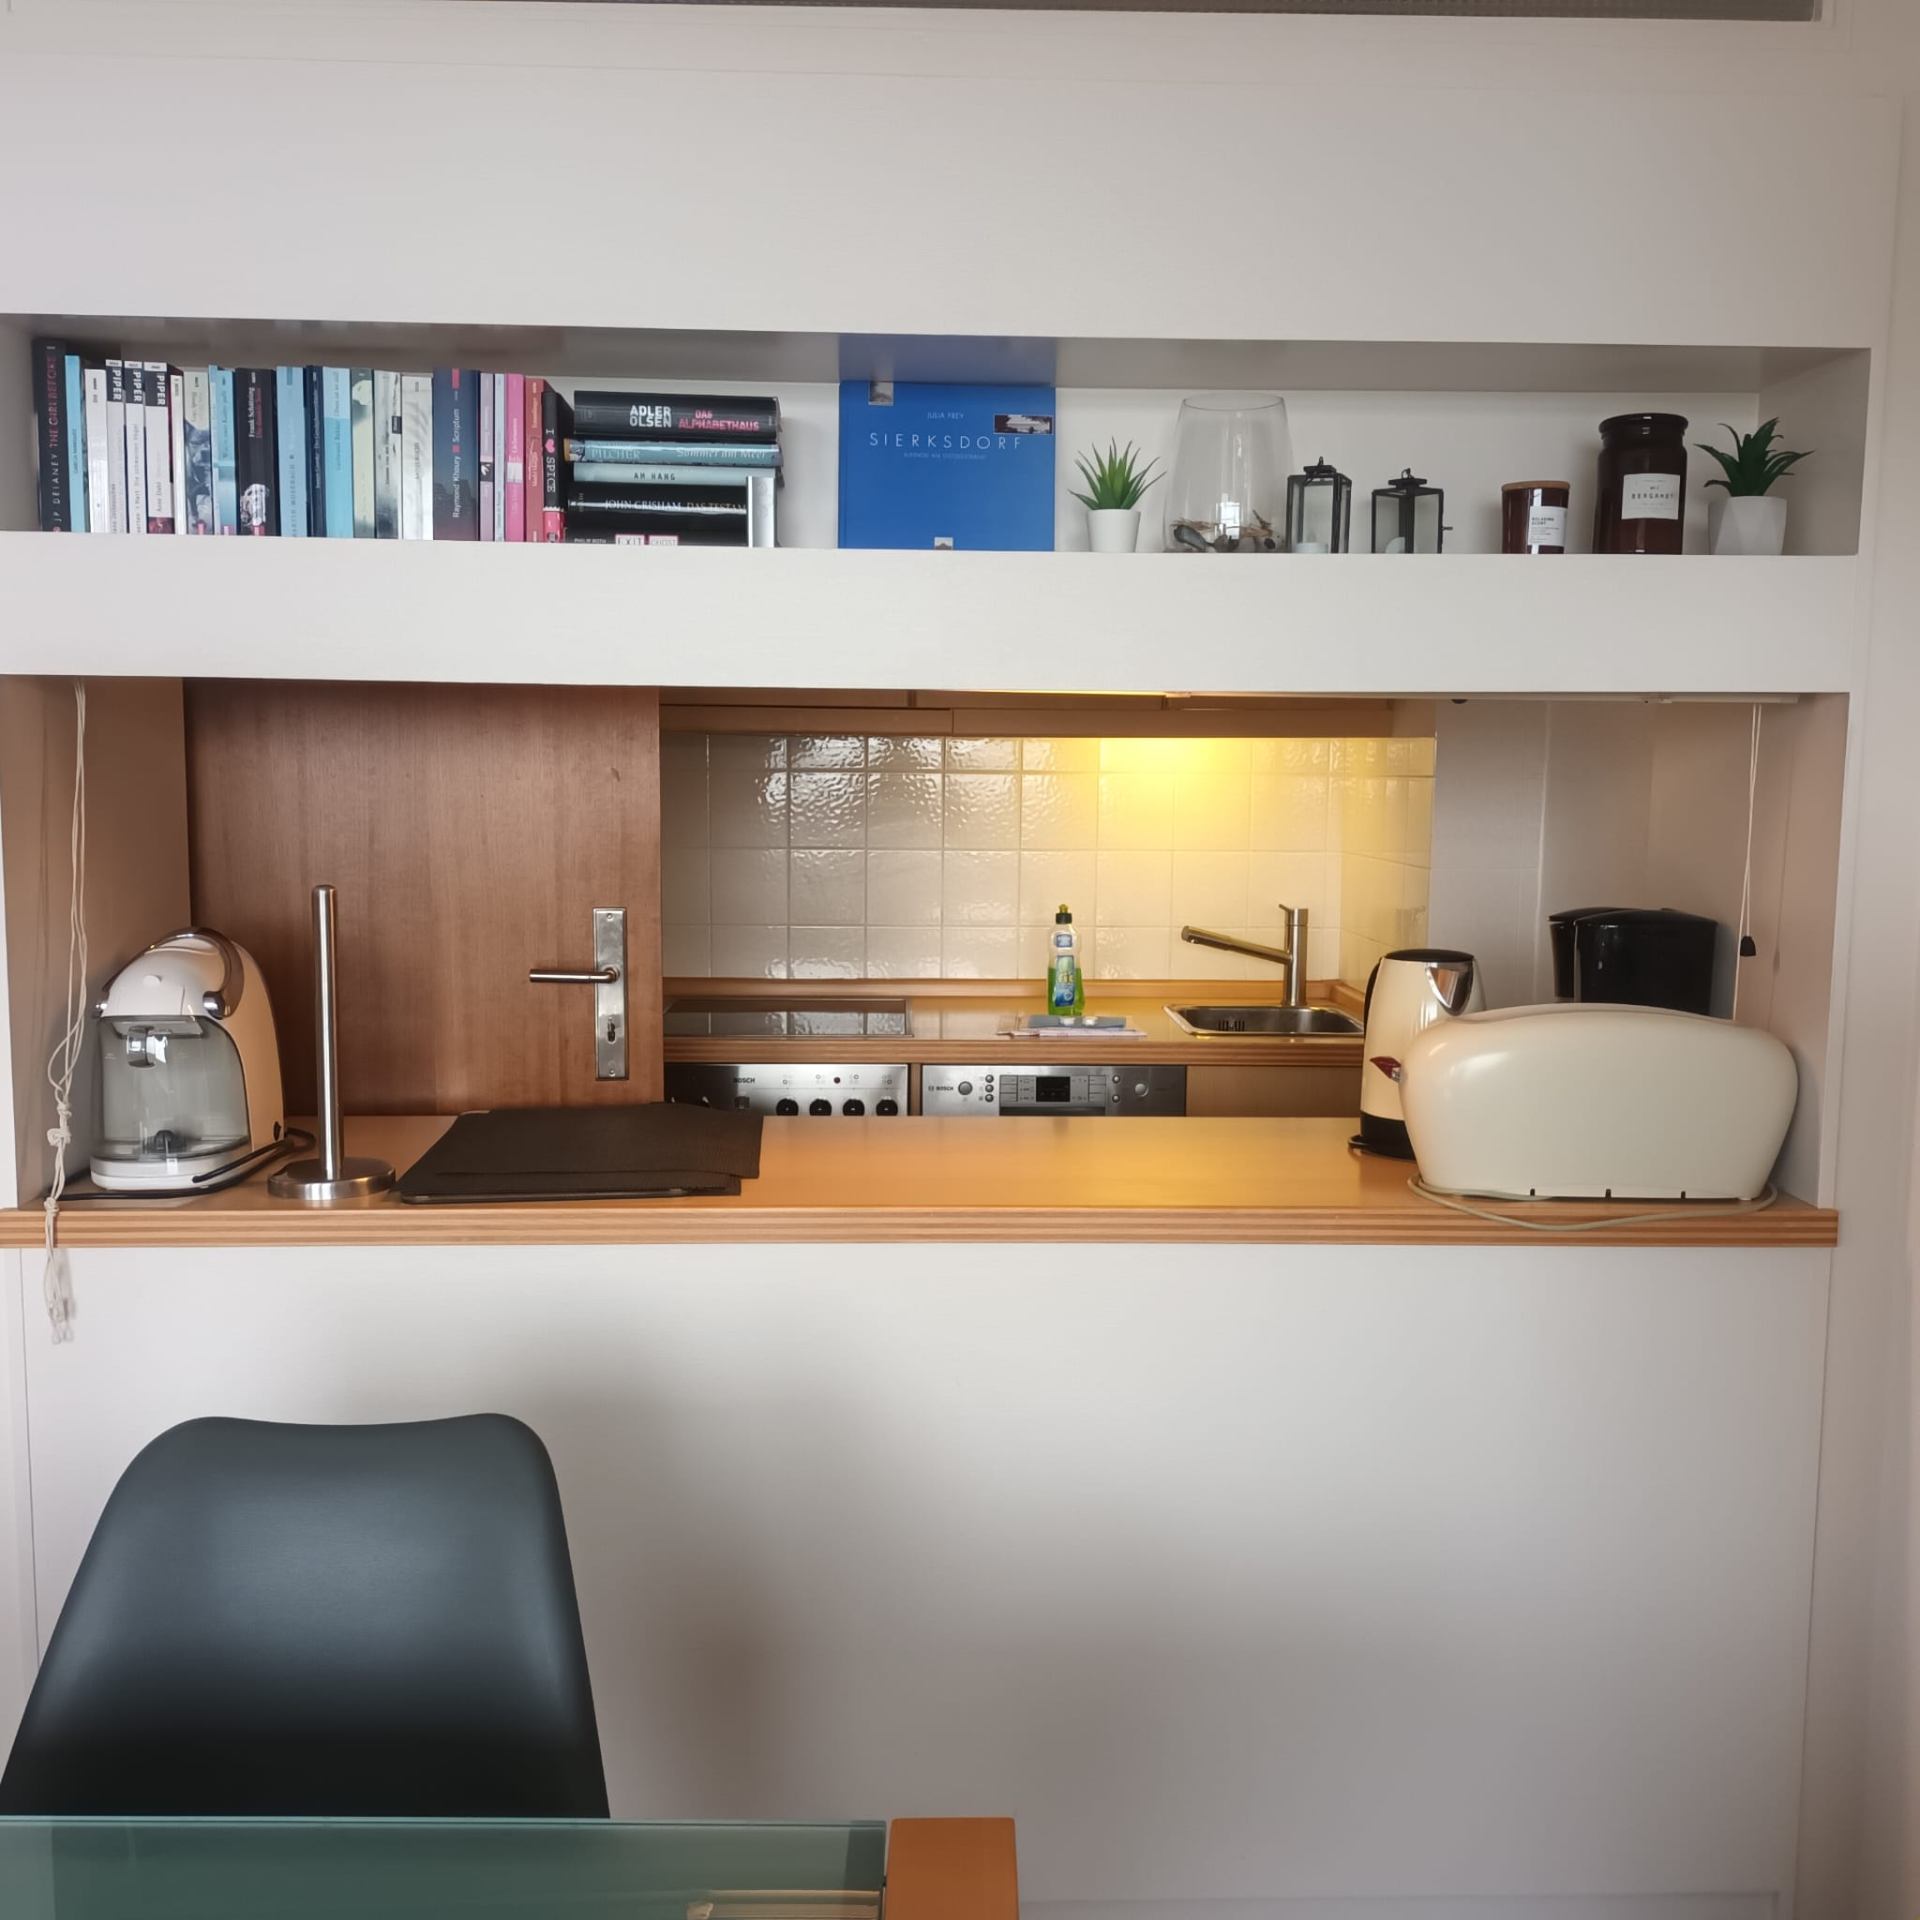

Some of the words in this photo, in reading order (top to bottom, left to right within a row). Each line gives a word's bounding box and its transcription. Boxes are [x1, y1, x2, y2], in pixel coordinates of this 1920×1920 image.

[112, 369, 122, 401] PIPER
[133, 372, 142, 402] PIPER
[156, 375, 166, 406] PIPER
[48, 401, 58, 426] GIRL
[630, 405, 672, 417] ADLER
[695, 410, 713, 419] DAS
[451, 408, 462, 443] Scriptum
[630, 415, 672, 428] OLSEN
[678, 418, 760, 431] ALPHABETHAUS
[49, 429, 59, 448] THE
[545, 428, 555, 436] I
[869, 432, 1022, 450] SIERKSDORF
[452, 456, 462, 481] Khoury
[546, 456, 556, 493] SPICE
[651, 473, 676, 481] HANG
[452, 484, 462, 518] Raymond
[605, 499, 632, 510] JOHN
[634, 500, 681, 511] GRISHAM
